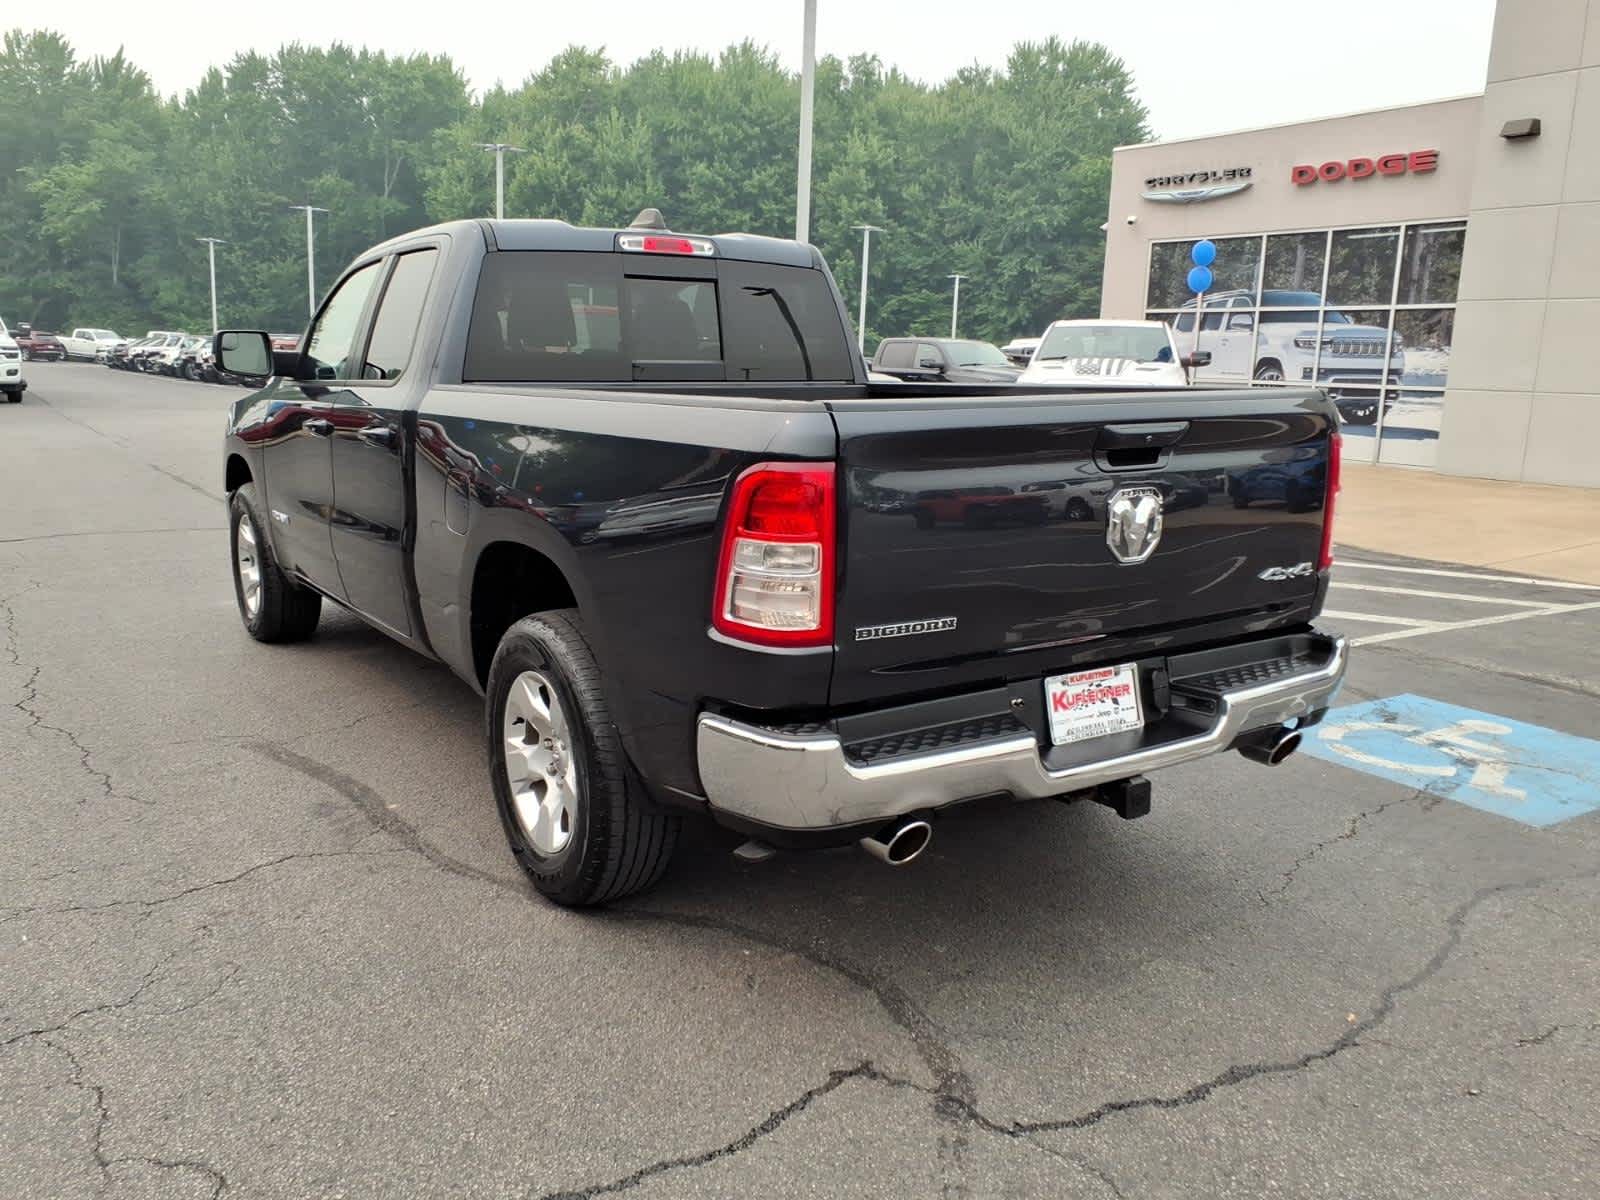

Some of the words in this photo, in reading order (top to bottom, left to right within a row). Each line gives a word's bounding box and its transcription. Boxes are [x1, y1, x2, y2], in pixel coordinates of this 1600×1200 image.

[1145, 167, 1252, 188] CHRYSLER
[1291, 150, 1439, 186] DODGE
[855, 617, 957, 641] BIGHORN
